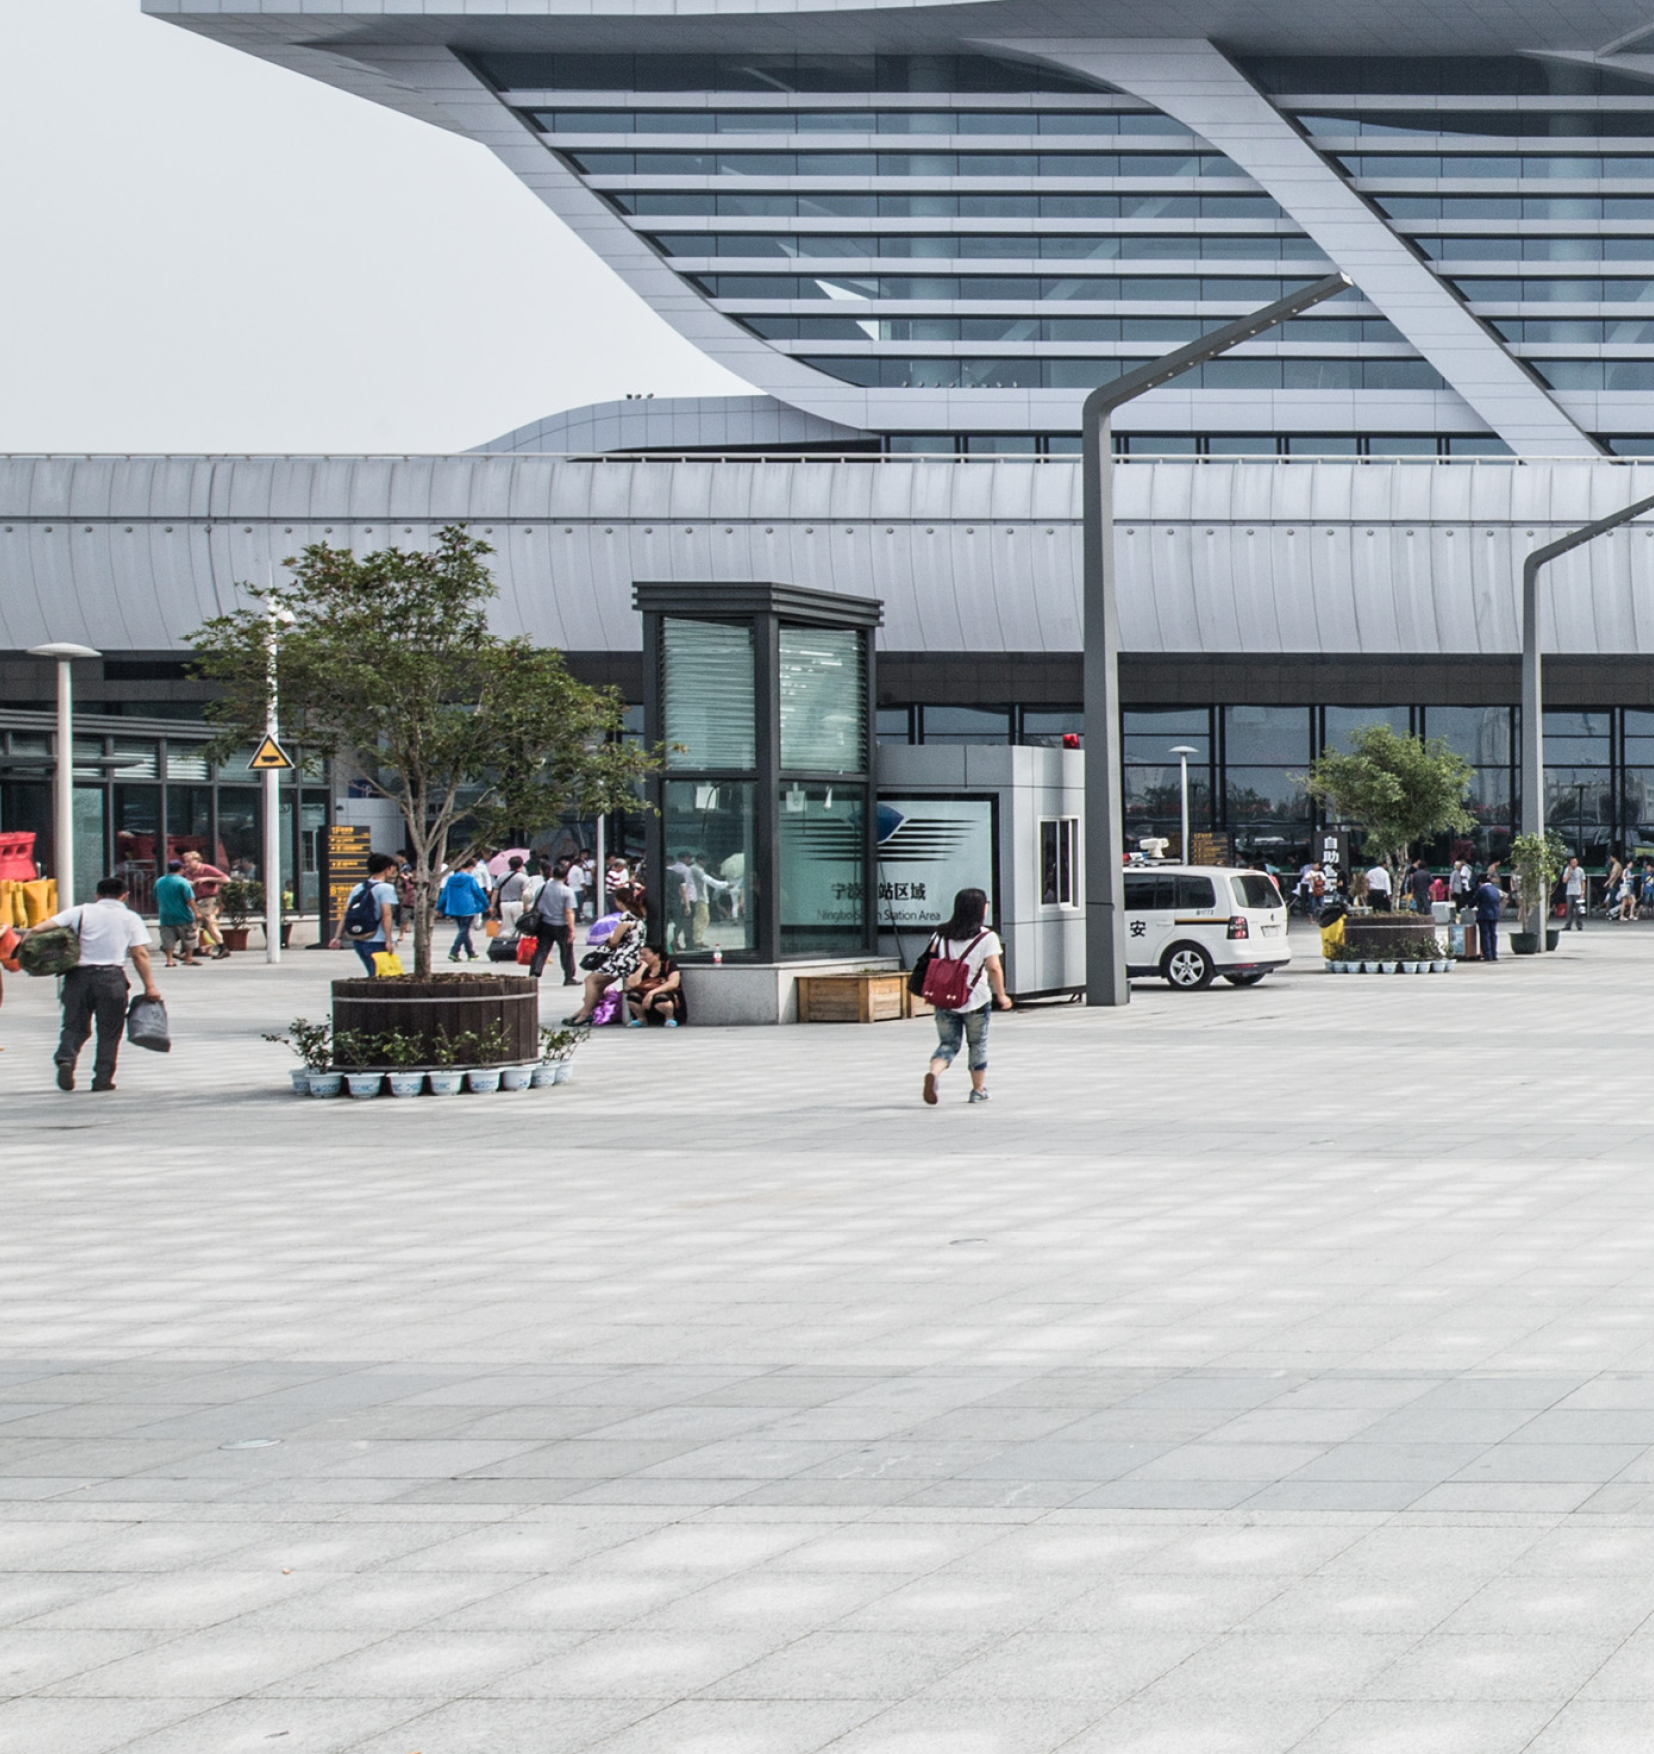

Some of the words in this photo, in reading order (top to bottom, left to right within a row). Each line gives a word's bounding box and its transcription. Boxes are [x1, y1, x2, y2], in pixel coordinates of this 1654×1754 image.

[831, 883, 926, 900] 宁波站区域
[884, 910, 917, 921] Station
[918, 910, 941, 921] Area
[1129, 920, 1147, 938] 安
